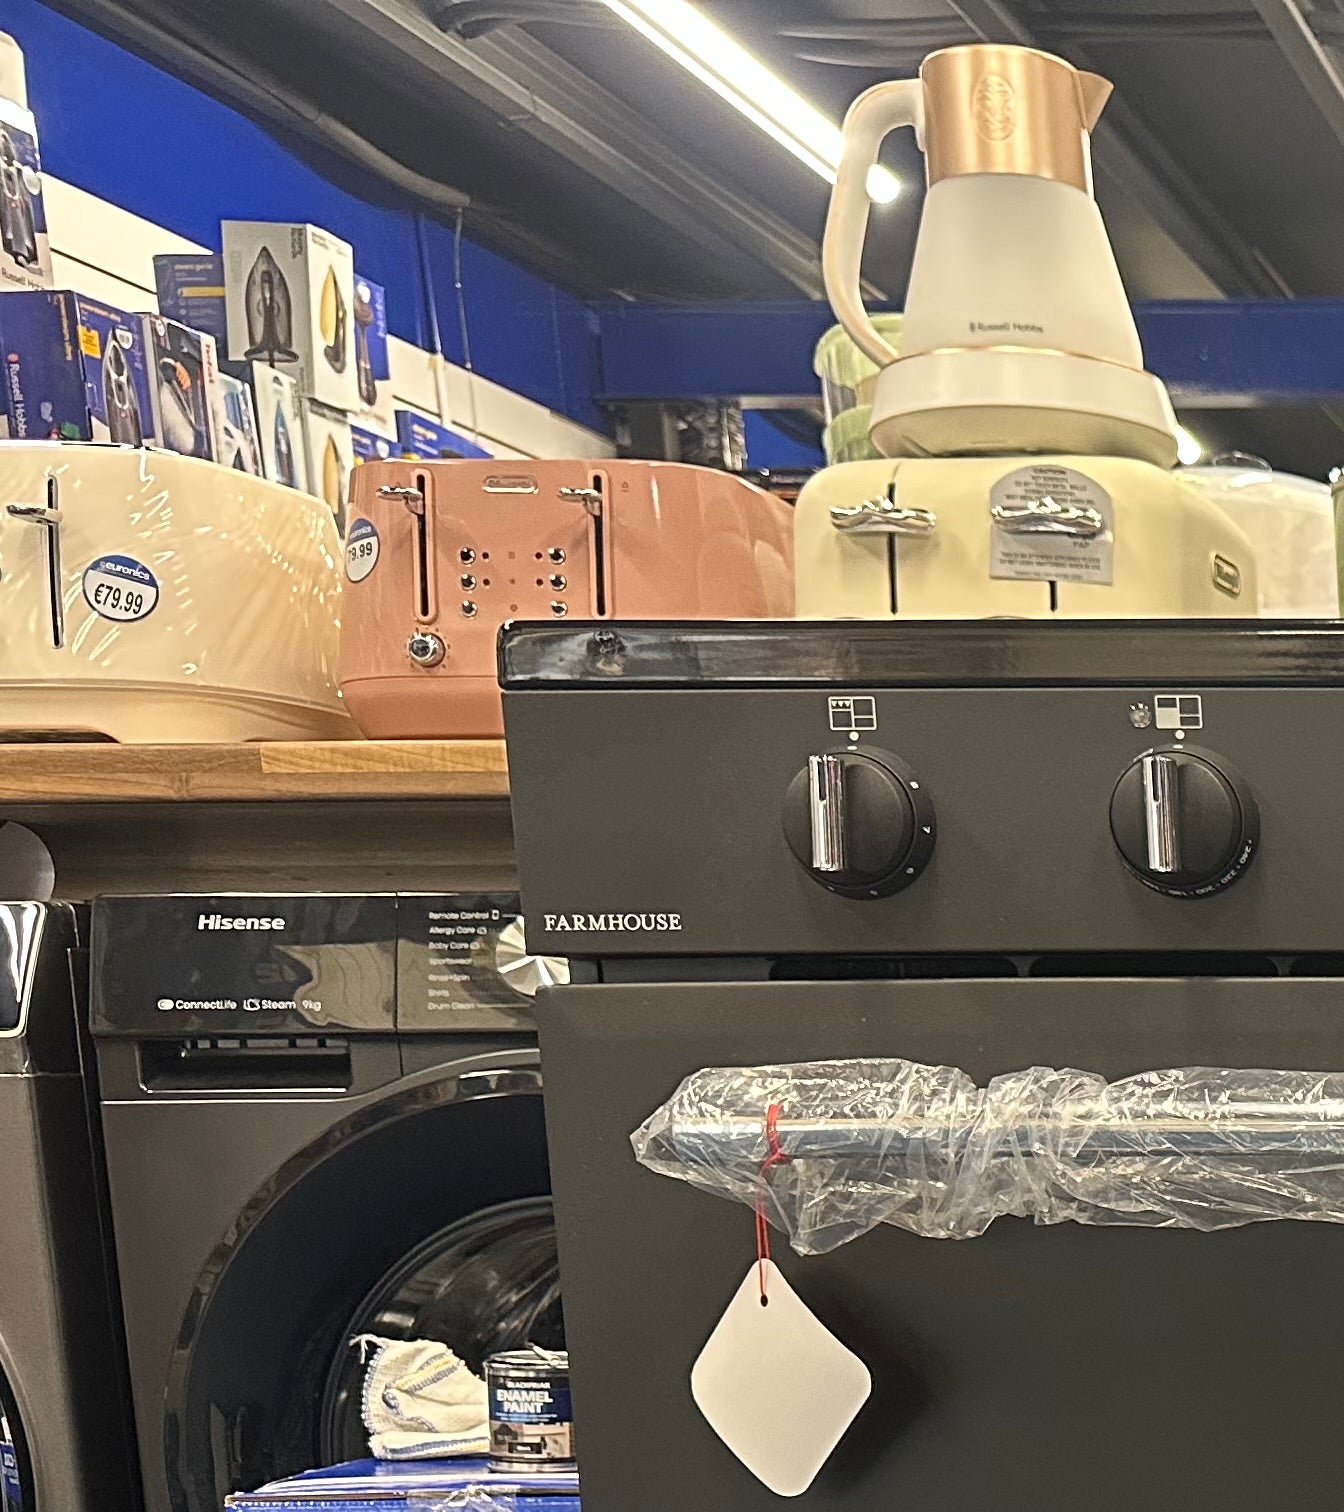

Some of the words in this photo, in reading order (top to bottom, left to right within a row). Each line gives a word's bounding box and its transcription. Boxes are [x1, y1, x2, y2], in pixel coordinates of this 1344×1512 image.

[104, 561, 151, 581] euronics
[94, 584, 144, 615] €79.99
[198, 914, 286, 930] Hisense
[428, 912, 460, 920] Remote
[460, 912, 489, 920] Control
[544, 914, 683, 931] FARMHOUSE
[429, 926, 455, 936] Allergy
[456, 926, 476, 934] Care
[175, 1000, 238, 1010] ConnectLife
[261, 1000, 297, 1010] Steam
[301, 1000, 322, 1012] 9kg
[496, 1389, 554, 1403] ENAMEL
[503, 1402, 544, 1413] PAINT
